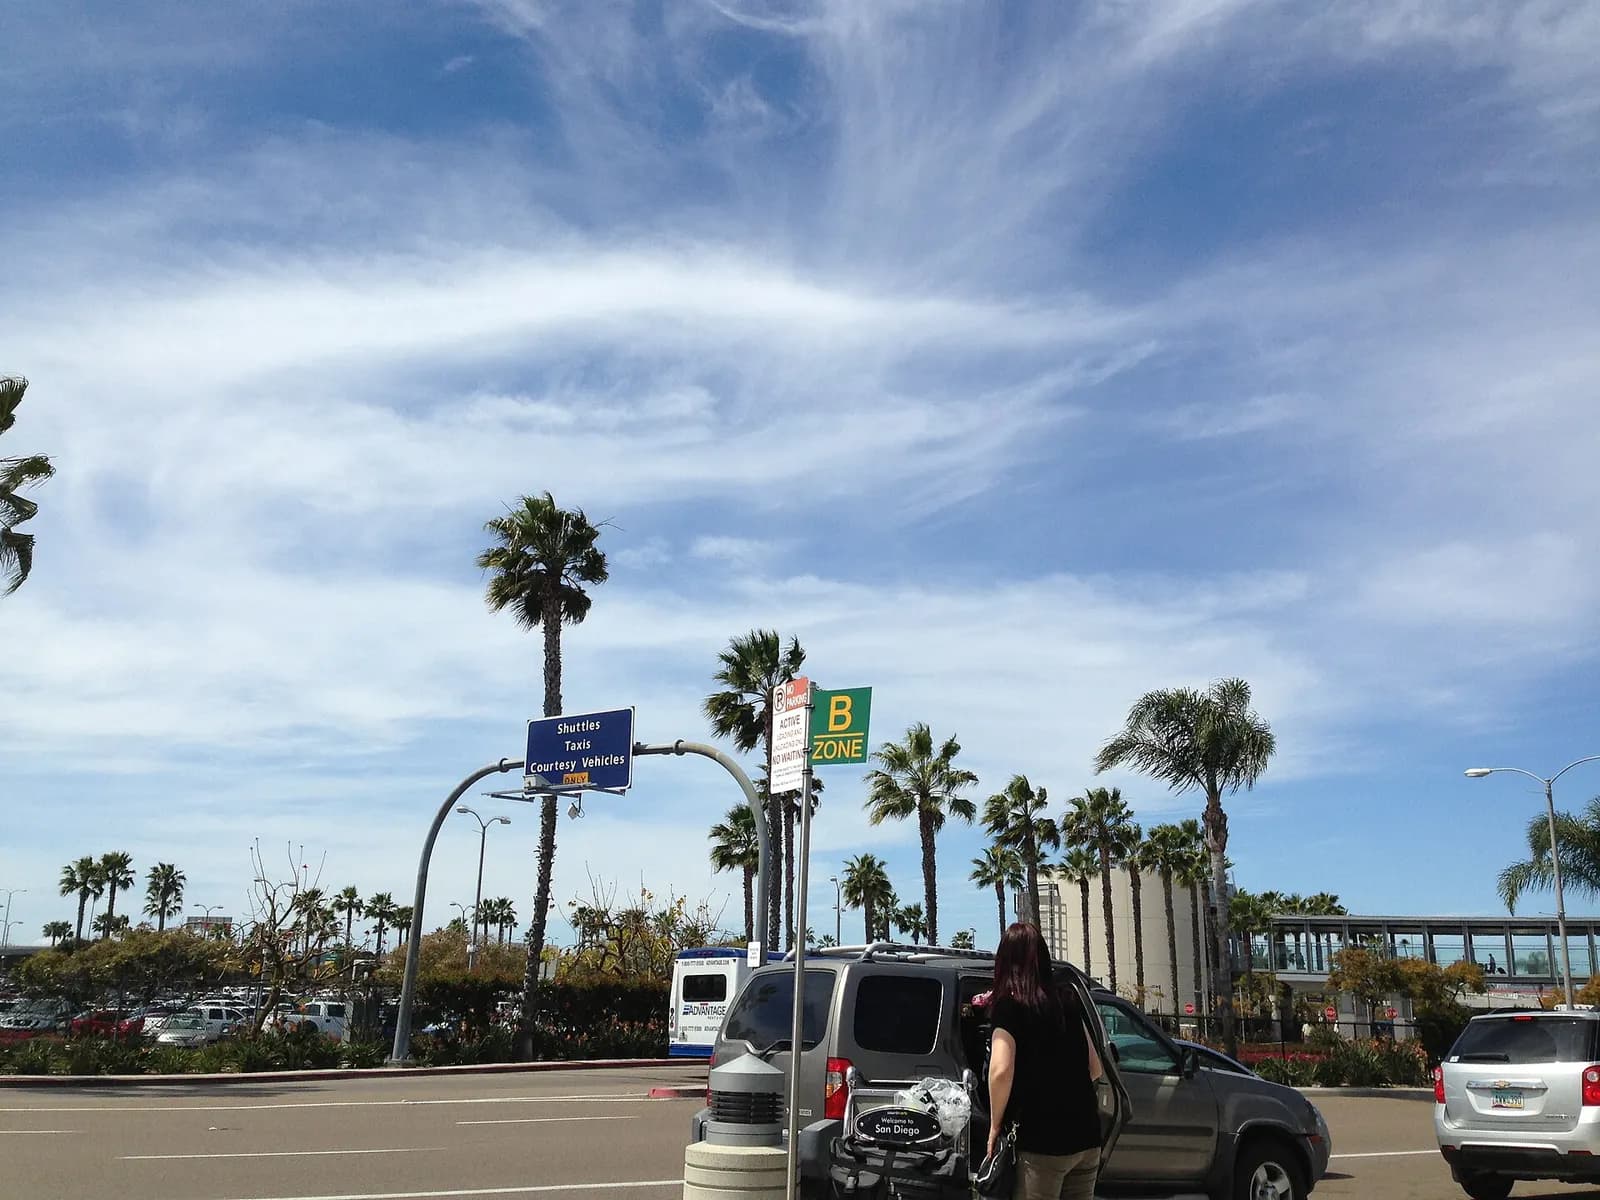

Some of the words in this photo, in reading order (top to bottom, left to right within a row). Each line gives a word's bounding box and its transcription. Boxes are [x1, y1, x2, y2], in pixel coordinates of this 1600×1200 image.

[786, 693, 808, 708] PARKING
[829, 695, 853, 731] B
[557, 720, 600, 734] Shuttles
[780, 714, 801, 729] ACTIVE
[565, 739, 591, 751] Taxis
[812, 739, 863, 760] ZONE
[530, 760, 577, 773] Courtesy
[582, 754, 625, 768] Vehicles
[772, 755, 781, 766] NO
[564, 776, 586, 784] ONLY
[690, 1005, 726, 1016] ADVANTAGE
[875, 1123, 891, 1133] San
[894, 1125, 920, 1136] Diego
